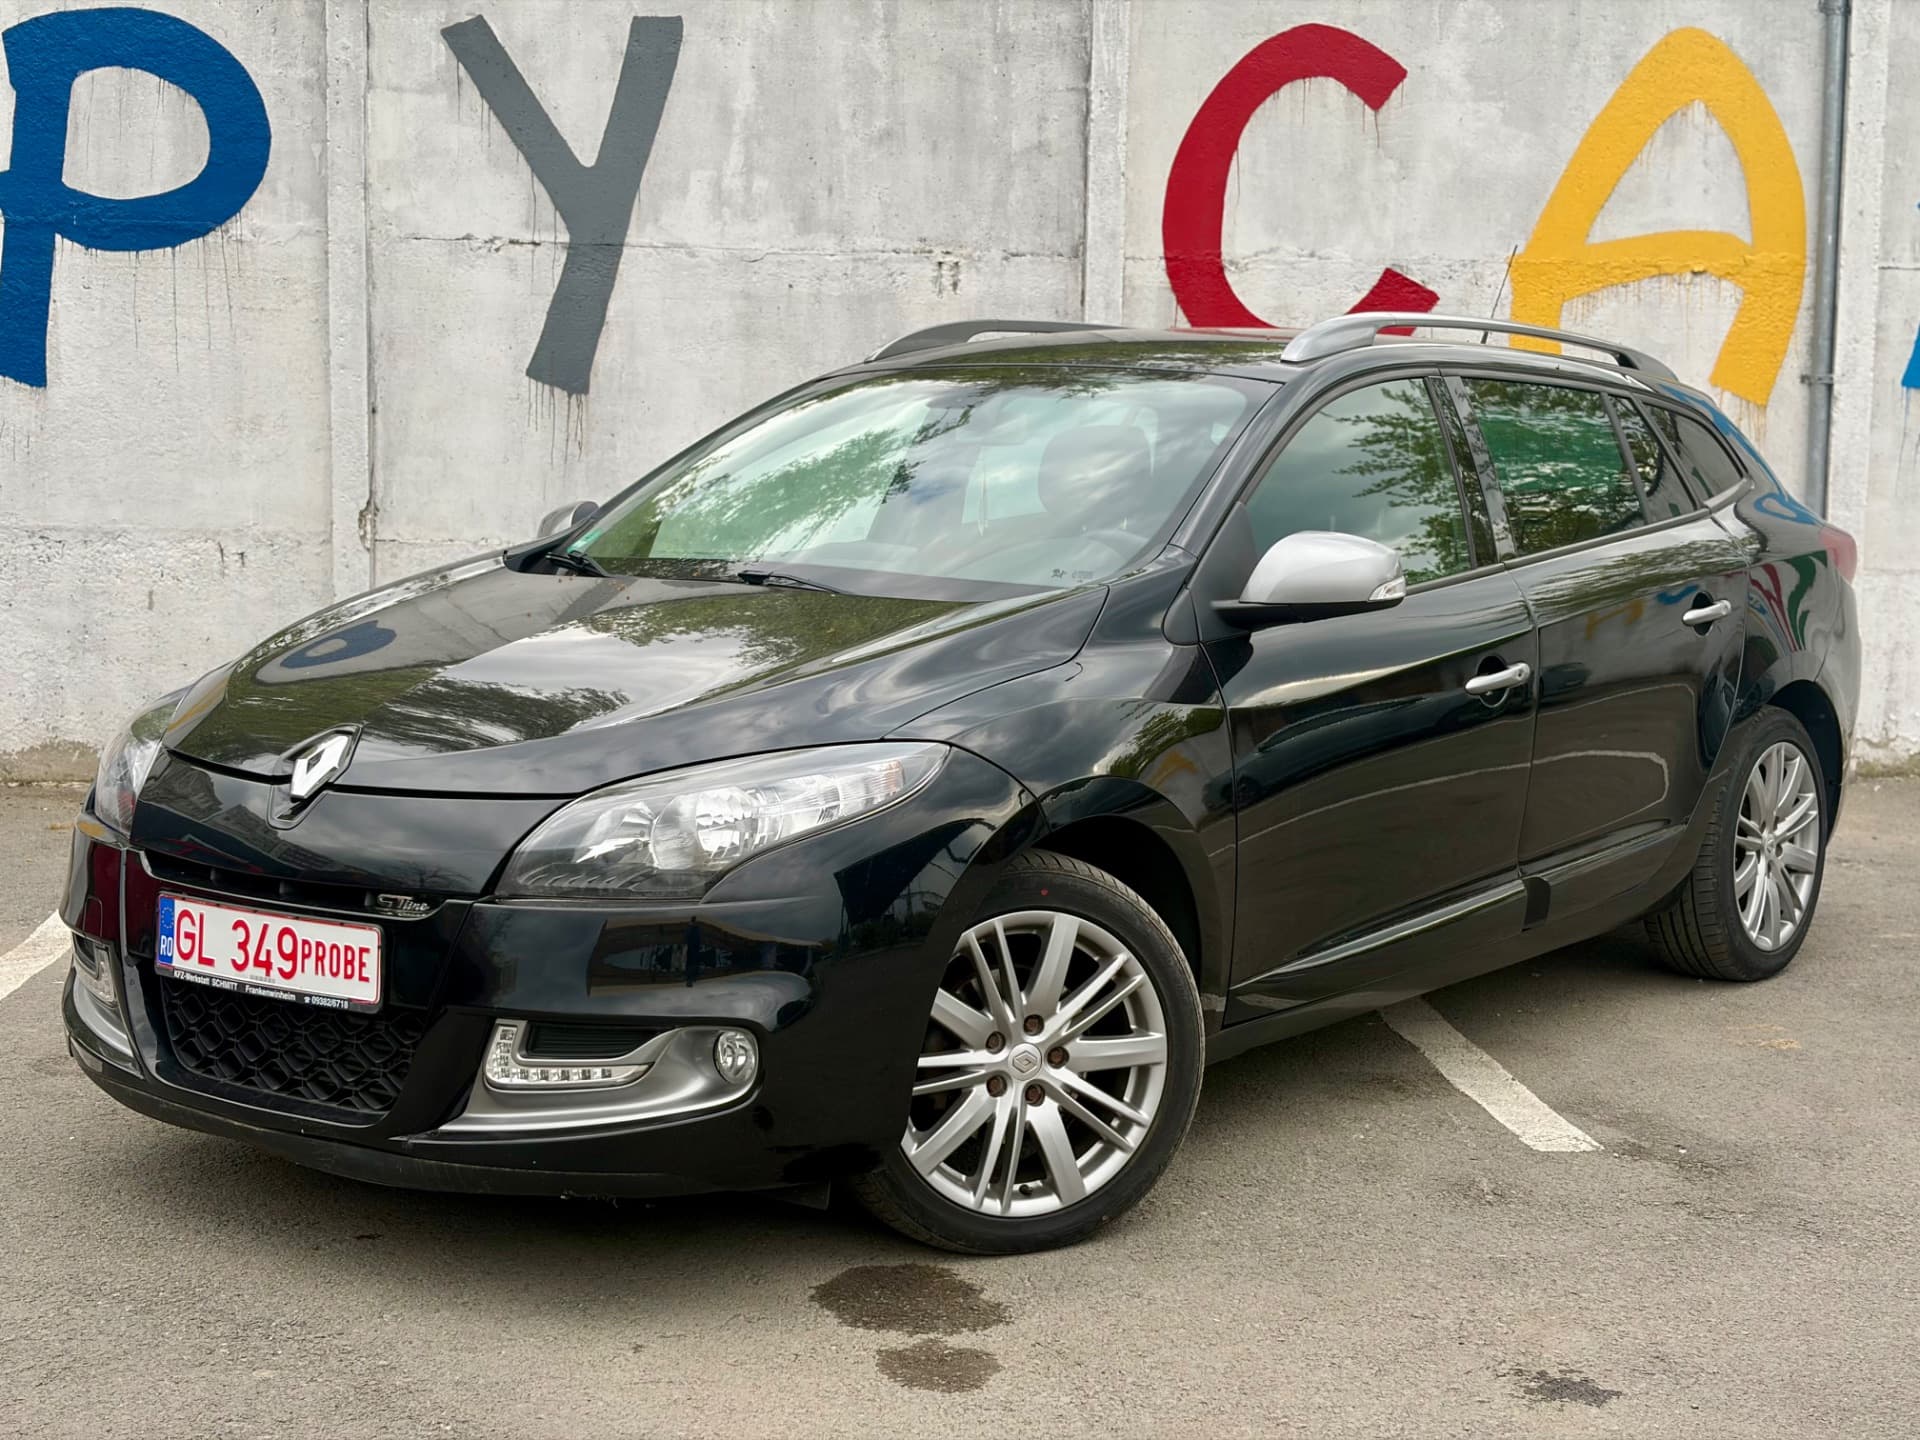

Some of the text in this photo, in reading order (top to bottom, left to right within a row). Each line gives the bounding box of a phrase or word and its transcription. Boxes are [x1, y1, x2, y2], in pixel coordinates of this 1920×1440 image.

[160, 935, 173, 957] RO
[176, 909, 370, 983] GL 349 PROBE
